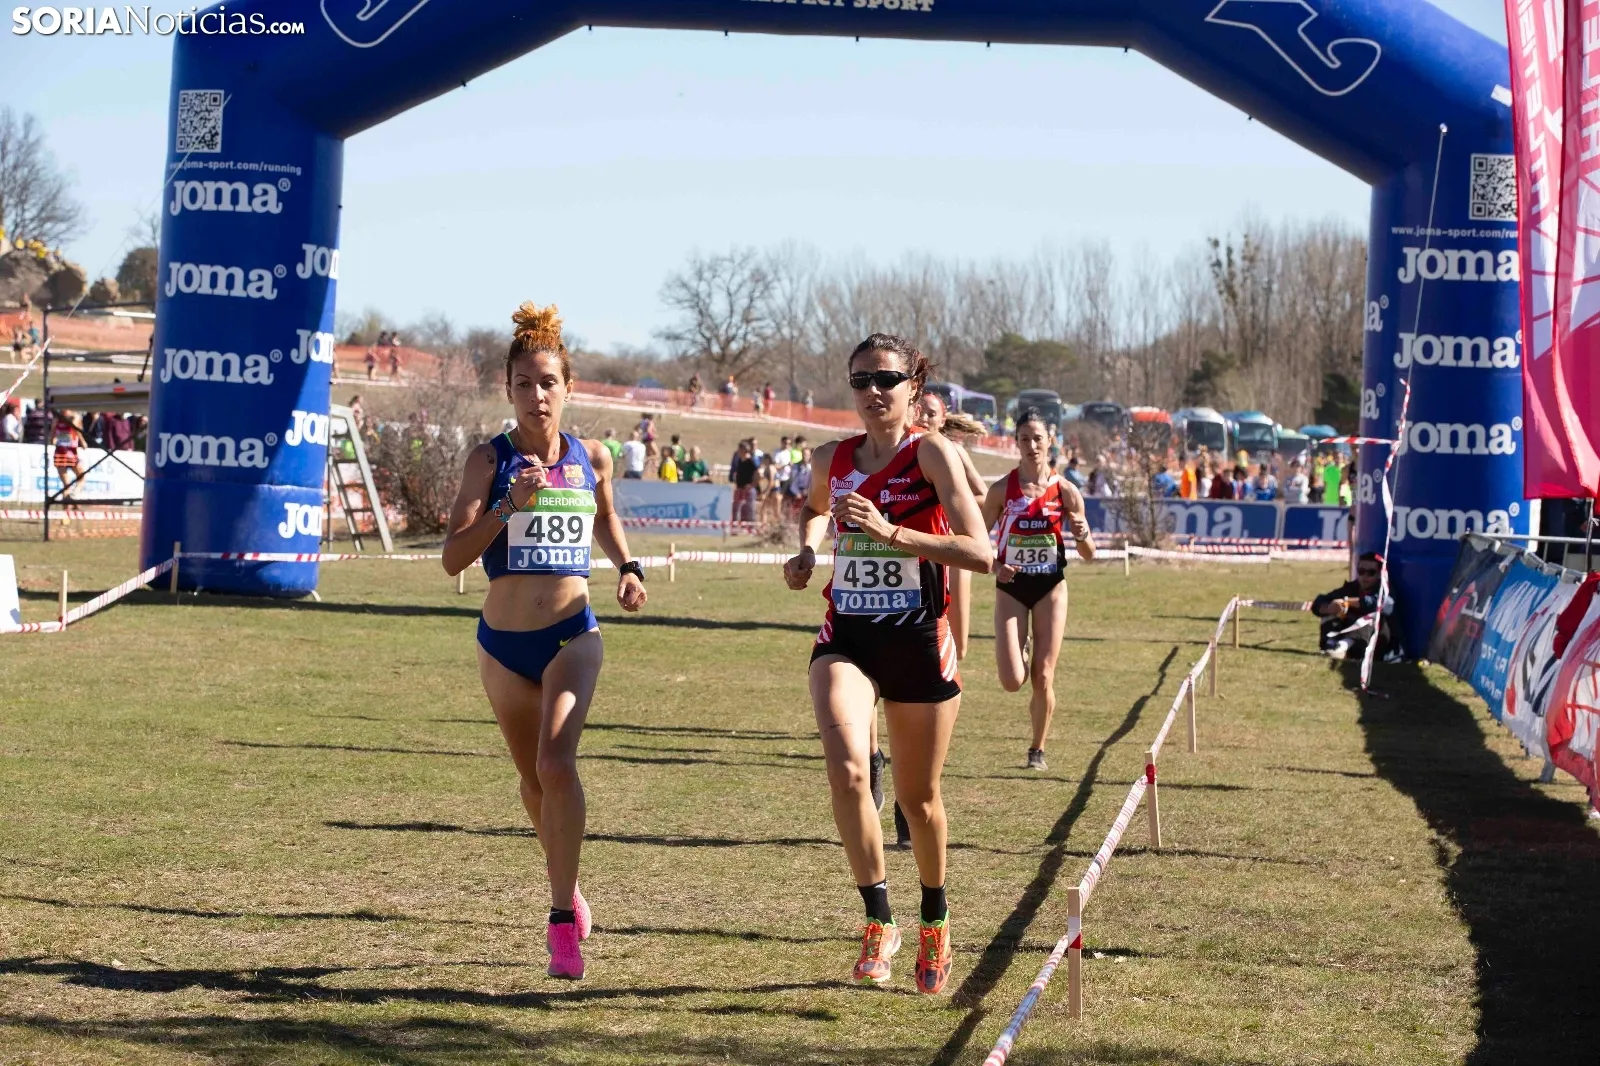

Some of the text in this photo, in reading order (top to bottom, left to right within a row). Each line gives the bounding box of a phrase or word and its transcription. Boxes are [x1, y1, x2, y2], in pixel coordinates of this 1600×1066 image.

[525, 516, 584, 543] 489
[1014, 548, 1048, 564] 436
[843, 560, 903, 588] 438
